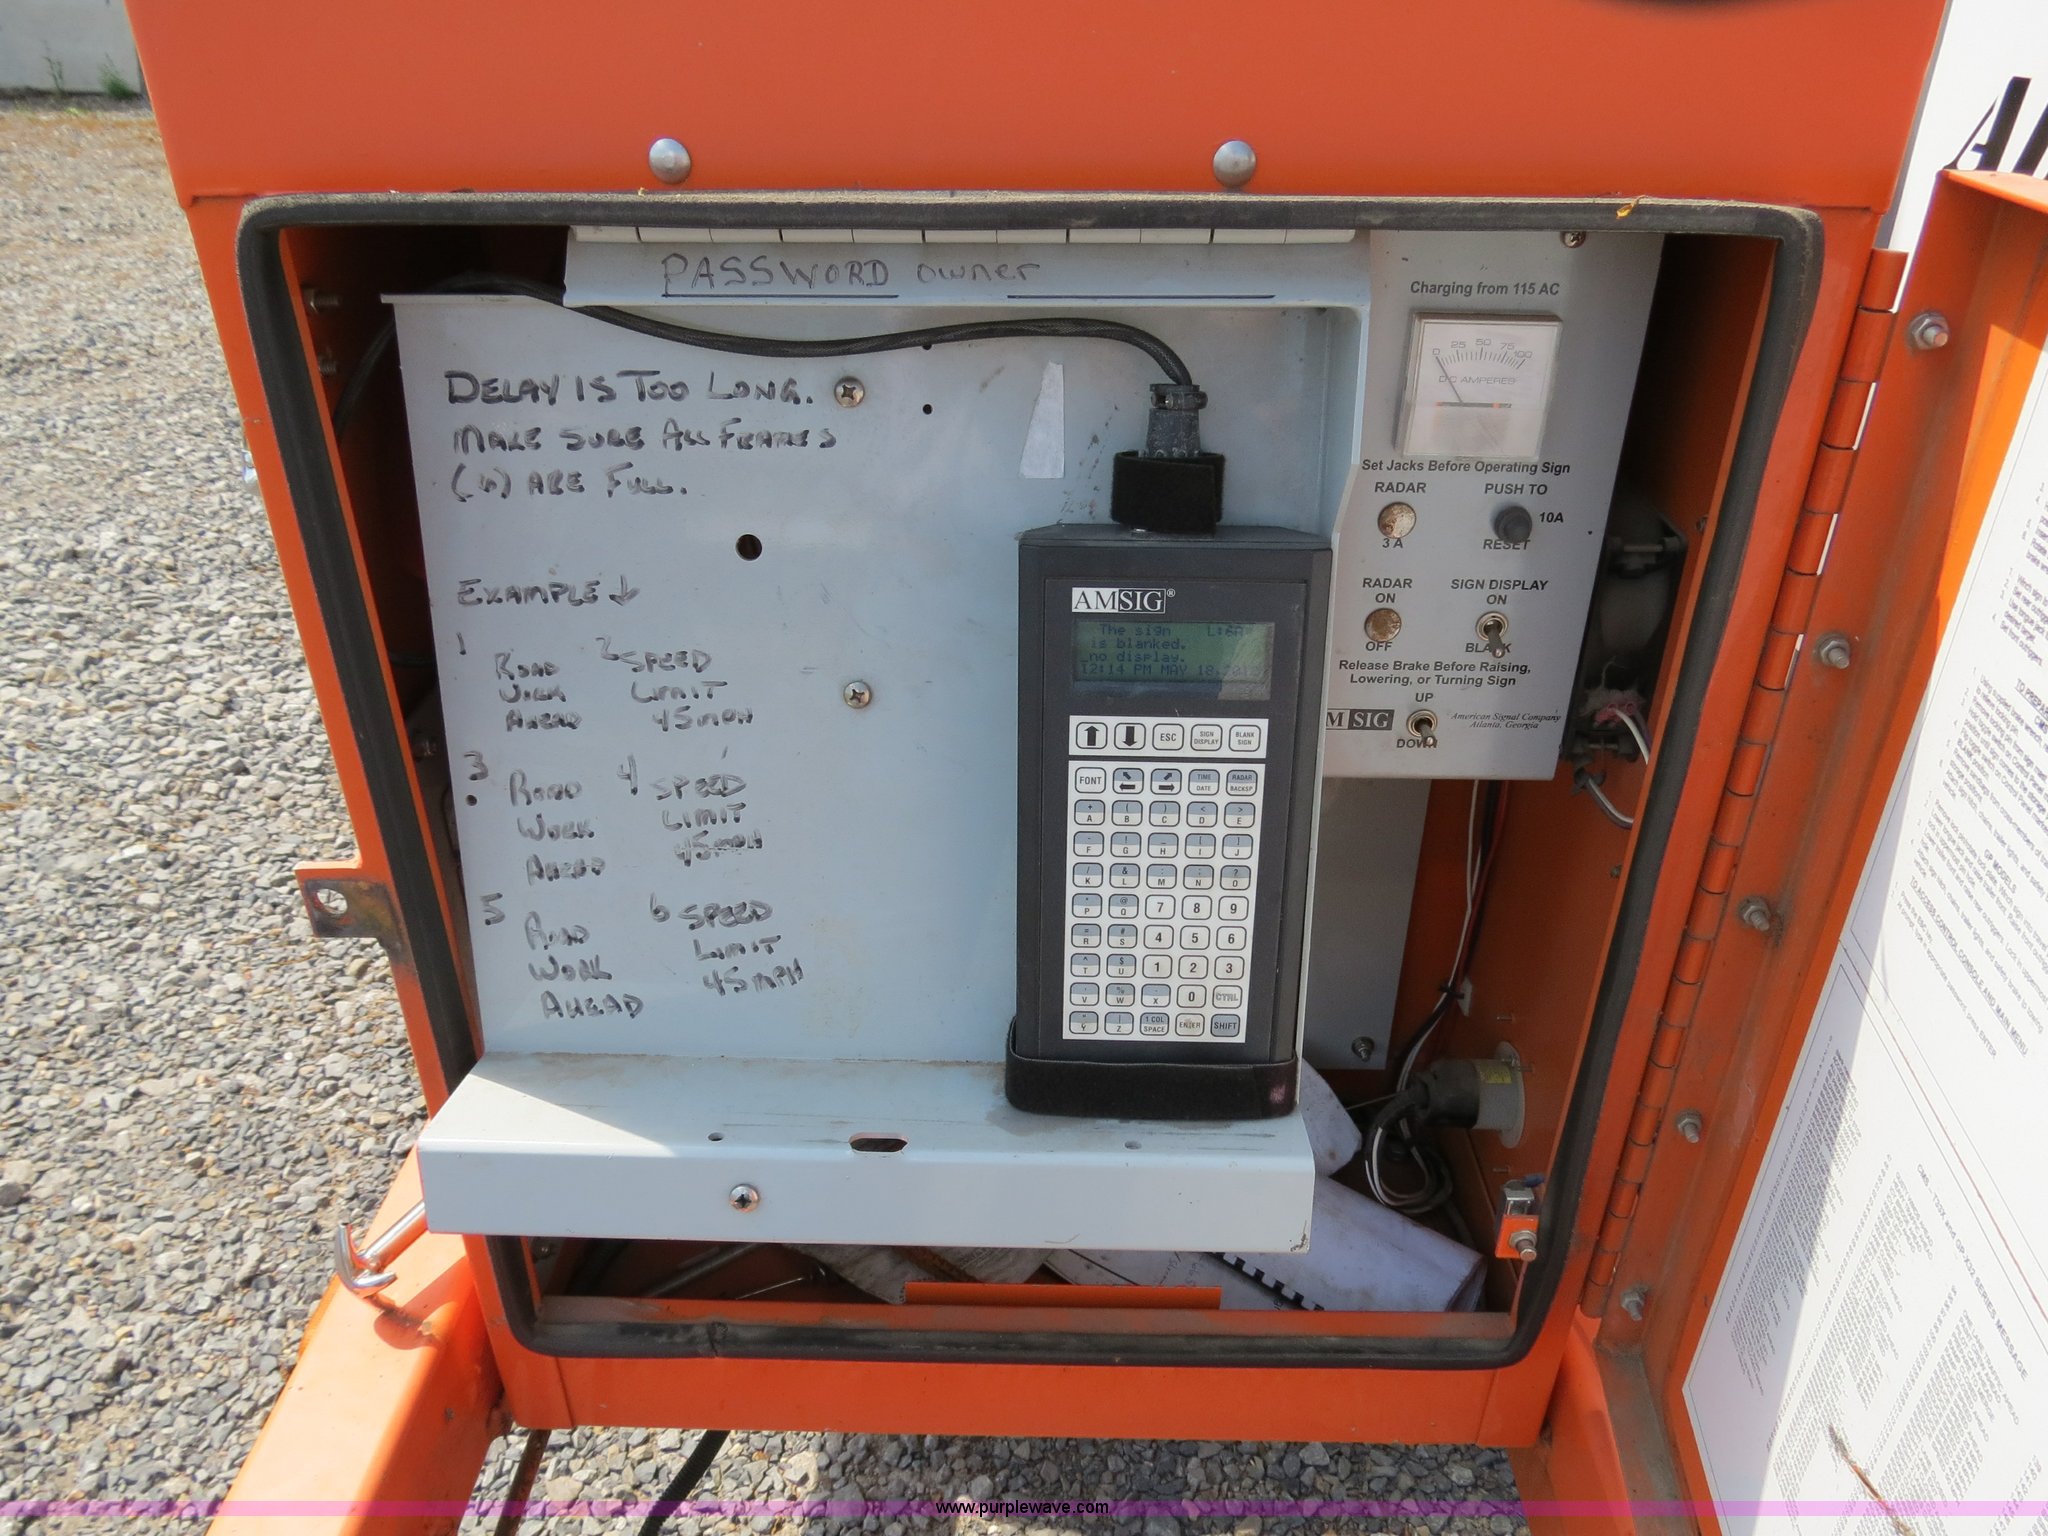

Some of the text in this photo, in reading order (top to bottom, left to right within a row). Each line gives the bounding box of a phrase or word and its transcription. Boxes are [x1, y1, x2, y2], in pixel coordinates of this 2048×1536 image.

[661, 252, 1040, 297] PASSWORD owner
[1410, 281, 1560, 297] Charging from 115 AC
[1450, 341, 1466, 349] 25
[1500, 342, 1515, 350] 75
[1513, 350, 1533, 359] 100
[1460, 376, 1516, 385] AMPERES
[444, 370, 559, 404] DELAY
[575, 375, 617, 402] IS
[617, 370, 690, 402] TOO
[454, 424, 542, 455] MAKE
[559, 426, 645, 451] SURE
[1362, 459, 1570, 477] Set Jacks Before Operating Sign
[528, 470, 585, 497] ARE
[1374, 481, 1427, 493] RADAR
[1484, 483, 1548, 496] PUSH TO
[1539, 512, 1564, 524] 10A
[1483, 539, 1530, 551] RESET
[1362, 577, 1413, 589] RADAR
[1450, 579, 1548, 591] SIGN DISPLAY
[457, 578, 601, 606] EXAMPLE
[1375, 593, 1396, 604] ON
[1486, 594, 1507, 605] ON
[1100, 624, 1126, 636] The
[1135, 625, 1171, 636] sign
[1116, 638, 1186, 650] blanked.
[1365, 641, 1393, 652] OFF
[1465, 642, 1512, 654] BLAK
[619, 650, 712, 673] SPEED
[1116, 651, 1185, 663] display.
[1081, 664, 1125, 675] 12:14
[1134, 664, 1152, 675] PM
[1161, 664, 1188, 676] MAY
[1339, 659, 1531, 675] Release Brake Before Raising,
[1350, 674, 1516, 688] Lowering, or Turning Sign
[1415, 692, 1434, 702] UP
[1451, 712, 1562, 723] American Signal Company
[1505, 721, 1539, 730] Georgia
[1160, 732, 1177, 742] ESC
[1235, 731, 1255, 739] BLANK
[1194, 738, 1219, 746] DISPLAY
[1079, 776, 1102, 785] FONT
[662, 802, 746, 831] LIMIT
[1157, 903, 1164, 913] 7
[1193, 903, 1200, 913] 8
[1230, 904, 1237, 914] 9
[678, 900, 773, 930] SPEED
[1155, 932, 1162, 943] 4
[1191, 933, 1199, 944] 5
[1228, 934, 1235, 944] 6
[1190, 963, 1197, 973] 2
[1225, 963, 1233, 974] 3
[1188, 991, 1195, 1002] 0
[541, 990, 644, 1019] AHEAD
[1214, 1021, 1237, 1030] SHIFT
